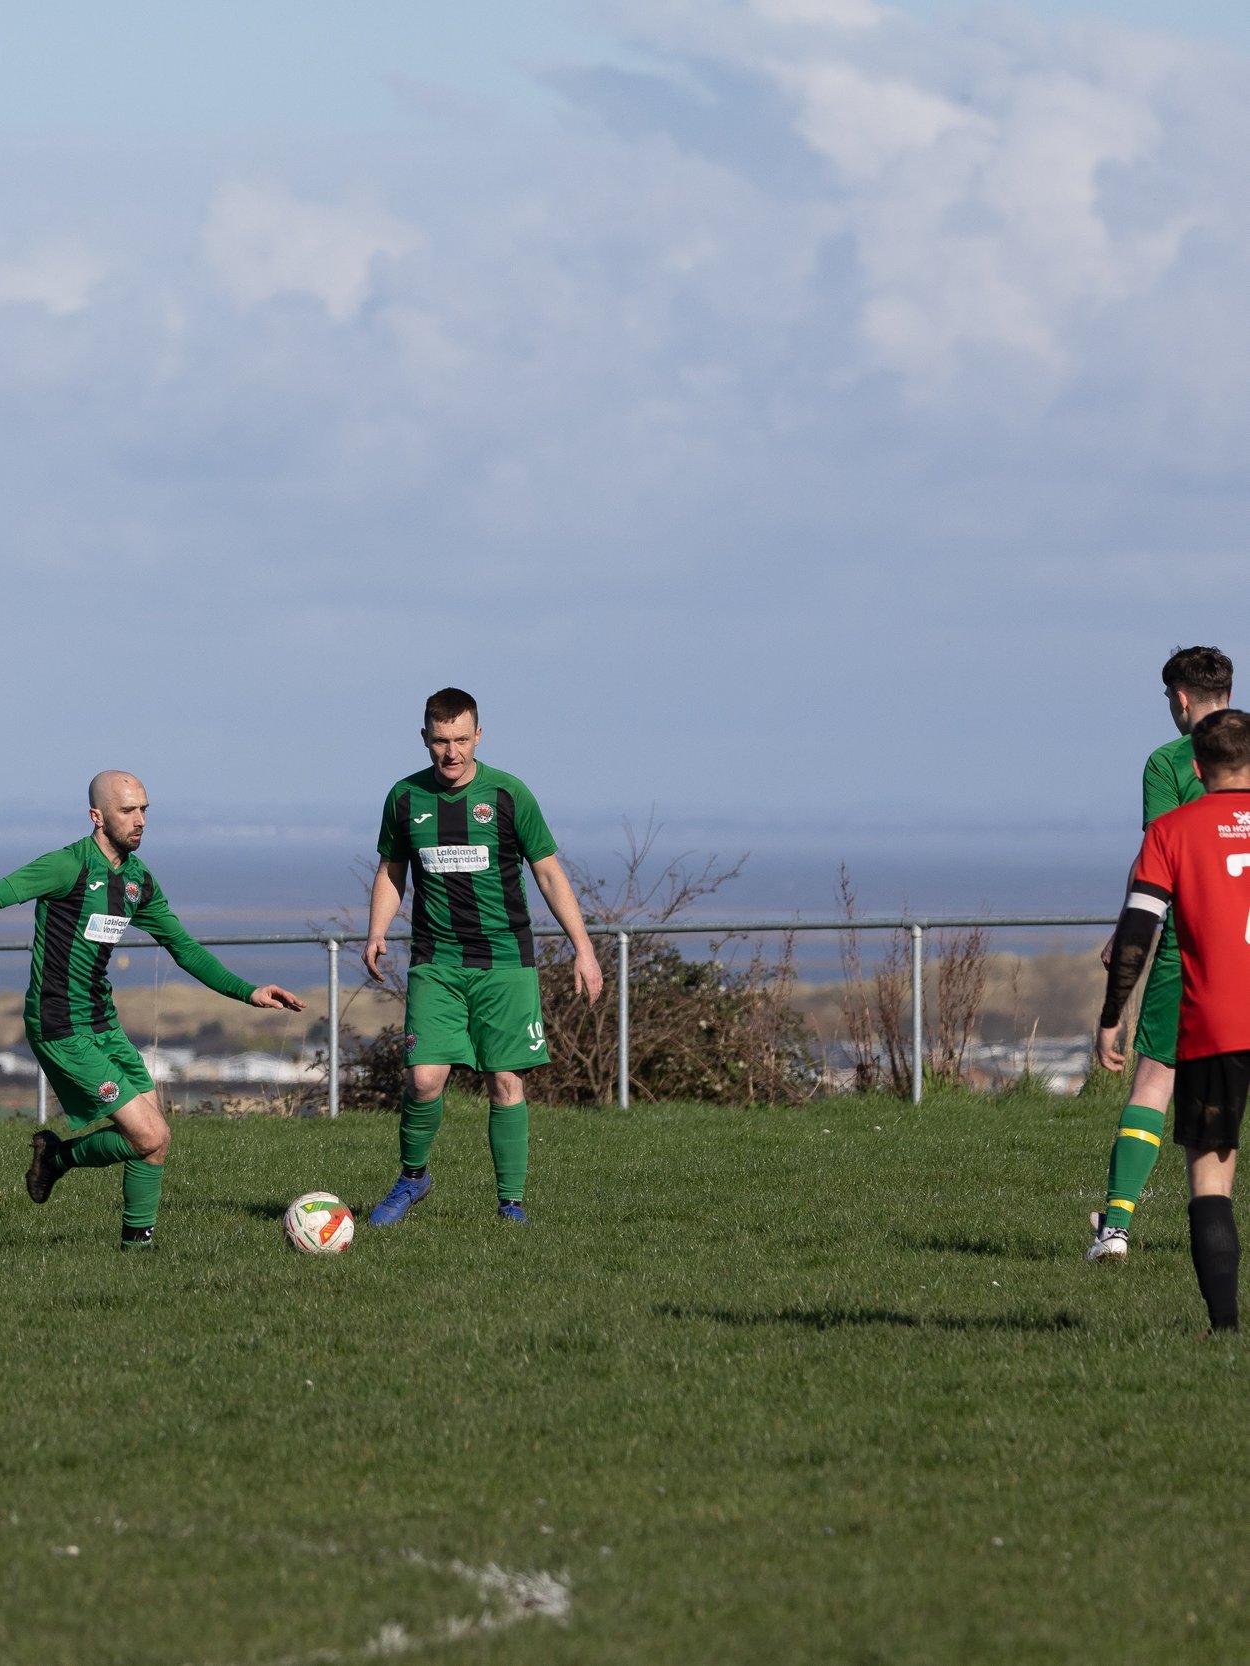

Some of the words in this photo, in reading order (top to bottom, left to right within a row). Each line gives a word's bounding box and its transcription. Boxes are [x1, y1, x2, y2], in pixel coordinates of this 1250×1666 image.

[436, 848, 478, 856] Lakeland
[437, 855, 487, 864] Verandahs
[527, 1021, 543, 1039] 10
